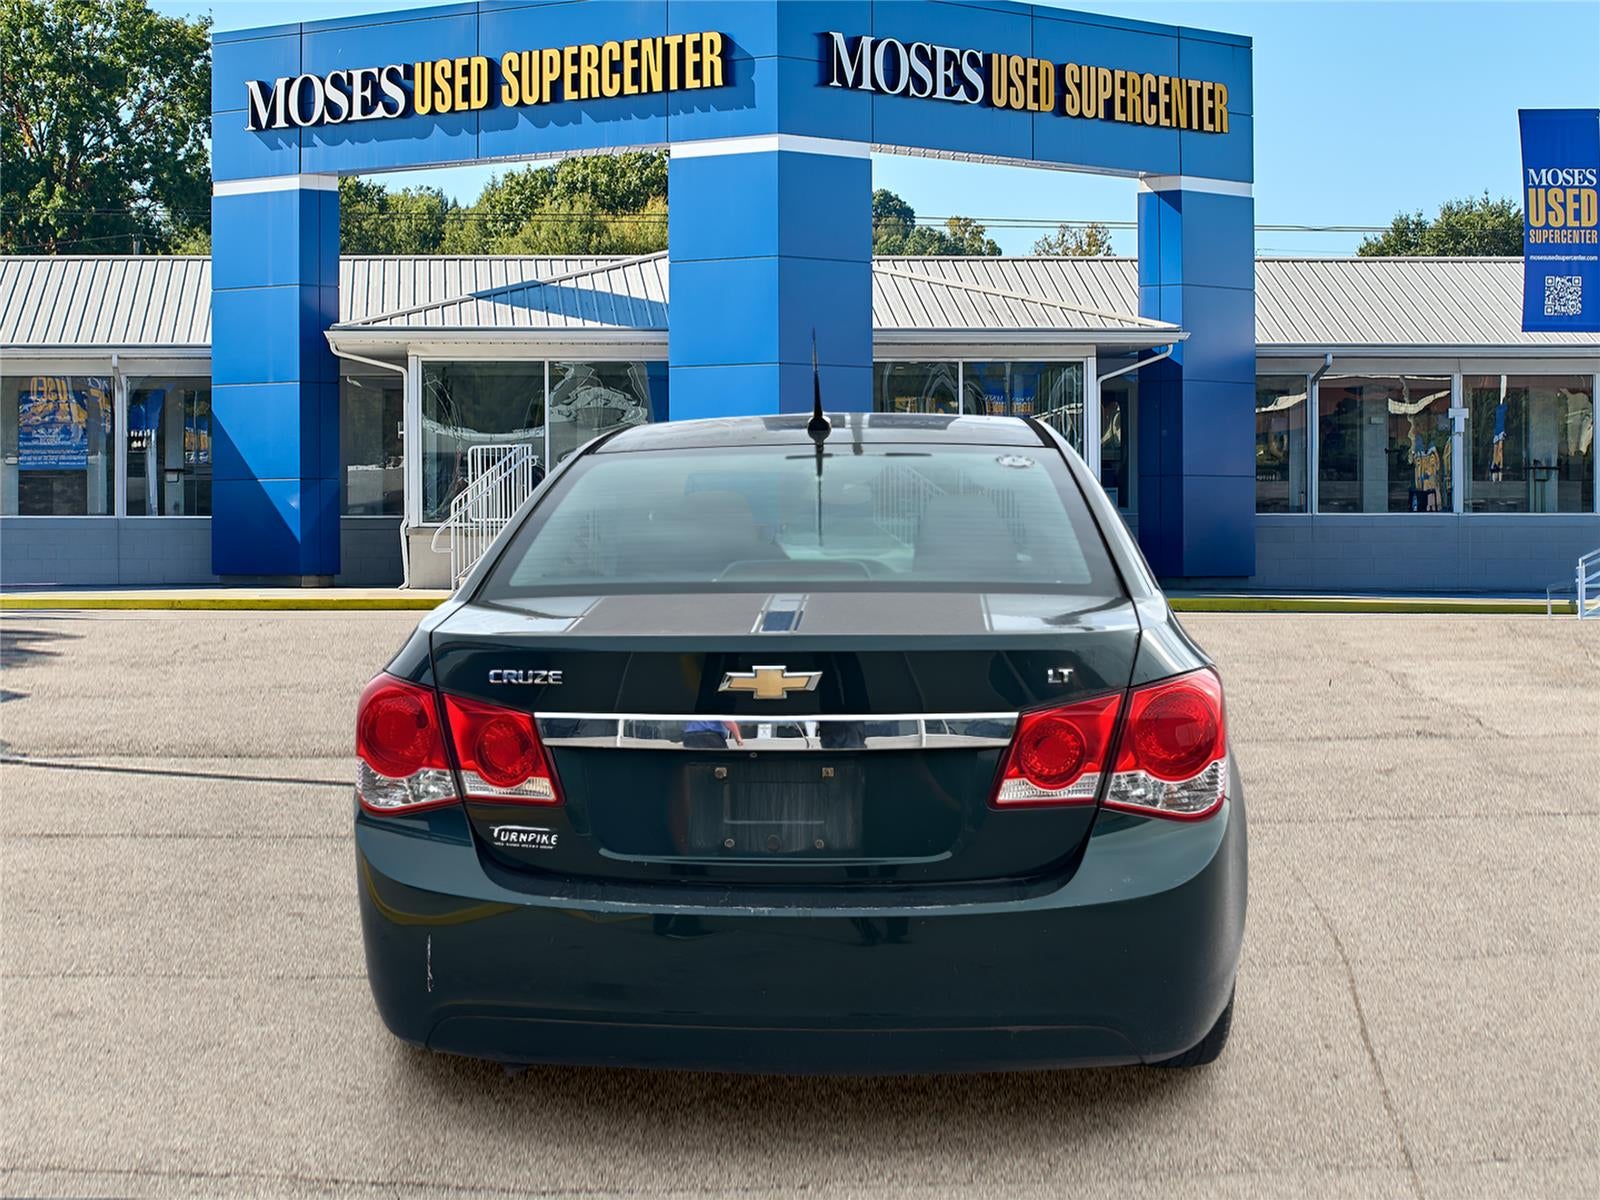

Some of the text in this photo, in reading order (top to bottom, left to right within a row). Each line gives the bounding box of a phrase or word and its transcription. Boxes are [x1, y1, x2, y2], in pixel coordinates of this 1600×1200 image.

[245, 31, 724, 131] MOSES USED SUPERCENTER
[829, 32, 1230, 133] MOSES USED SUPERCENTER
[1528, 168, 1597, 186] MOSES
[1528, 187, 1598, 227] USED
[1529, 229, 1598, 244] SUPERCENTER
[488, 669, 563, 684] CRUZE
[1047, 668, 1074, 683] LT
